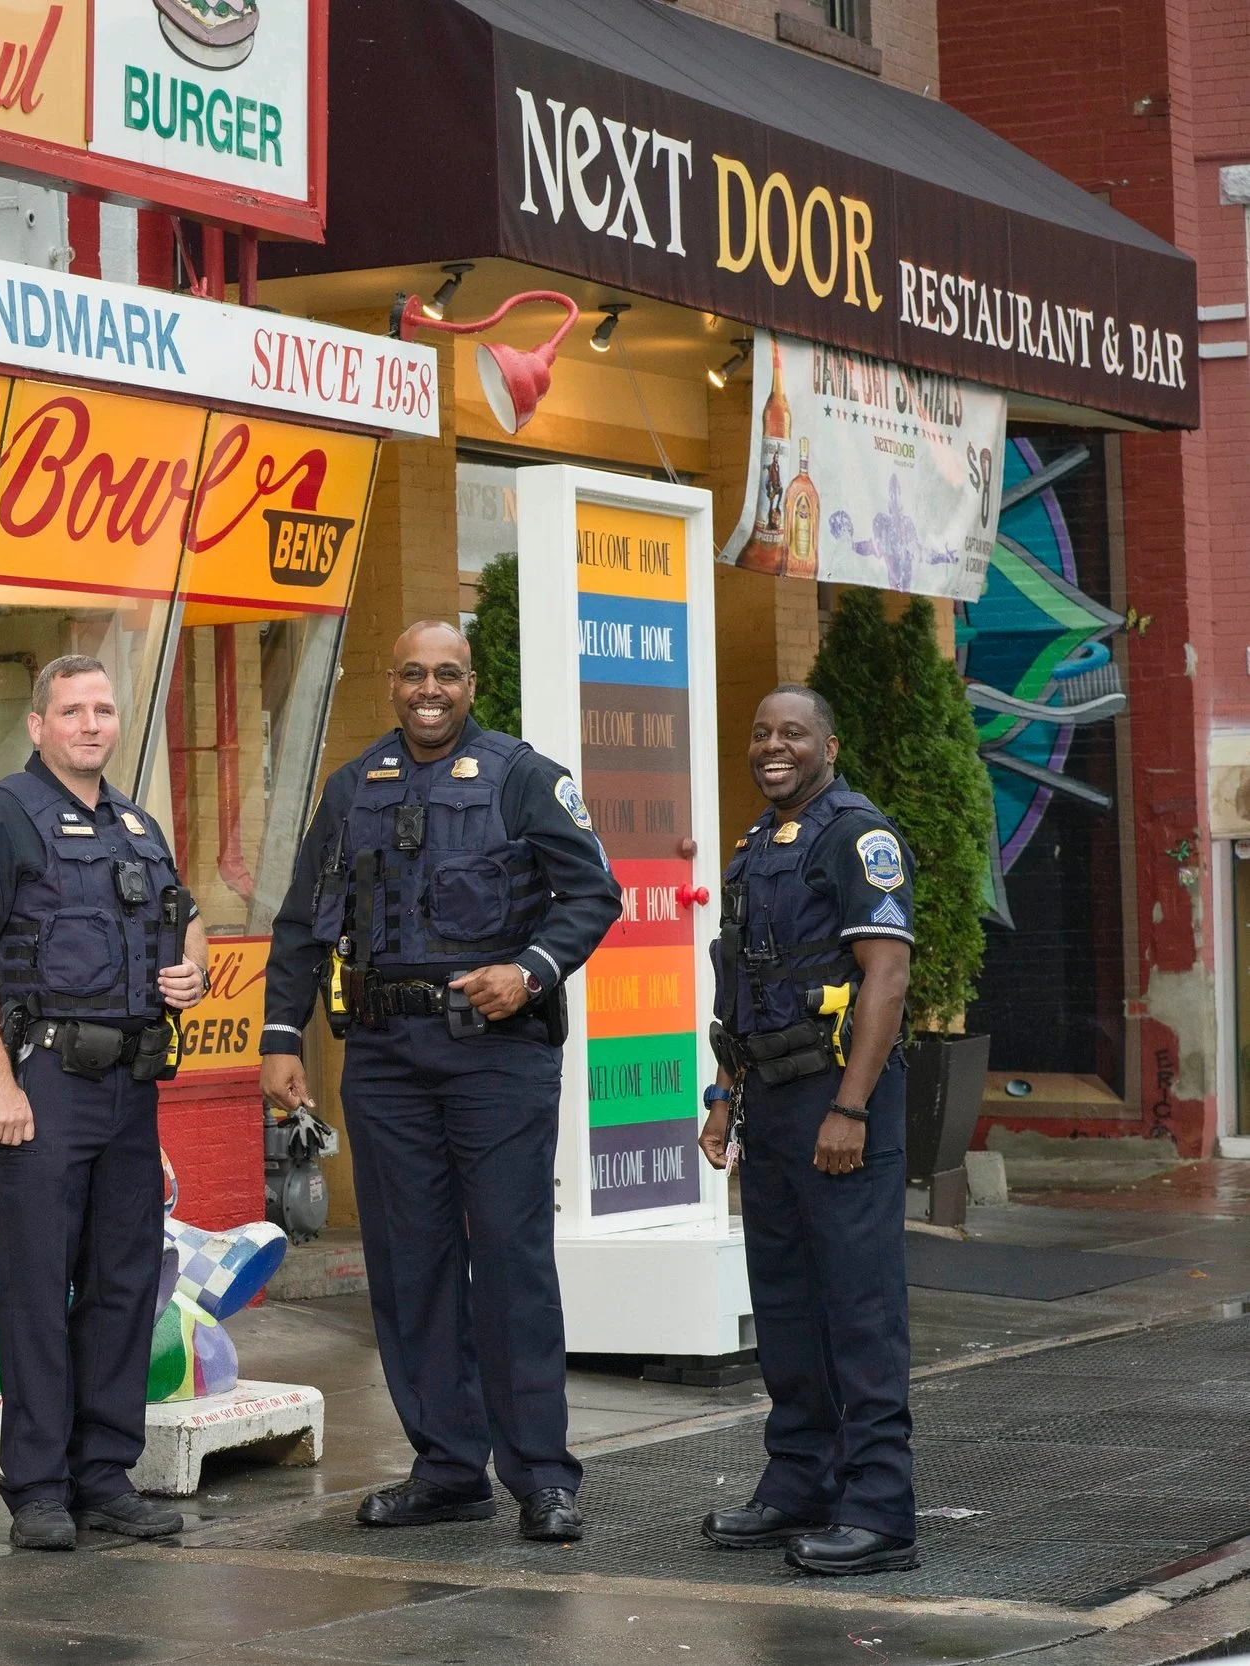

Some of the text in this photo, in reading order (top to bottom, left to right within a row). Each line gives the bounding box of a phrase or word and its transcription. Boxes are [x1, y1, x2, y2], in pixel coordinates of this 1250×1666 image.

[125, 65, 282, 167] BURGER
[713, 154, 883, 313] DOOR
[899, 259, 1094, 369] RESTAURANT
[1101, 316, 1125, 376] &
[1131, 323, 1188, 391] BAR
[252, 328, 433, 419] SINCE 1958
[273, 528, 338, 574] BEN'S
[639, 539, 672, 576] HOME
[640, 625, 674, 662] HOME
[643, 713, 676, 749] HOME
[590, 799, 676, 833] ELCOME HOME
[646, 886, 680, 921] HOME
[649, 972, 683, 1009] HOME
[182, 1017, 250, 1056] GERS
[651, 1059, 683, 1095] HOME
[653, 1145, 685, 1183] HOME
